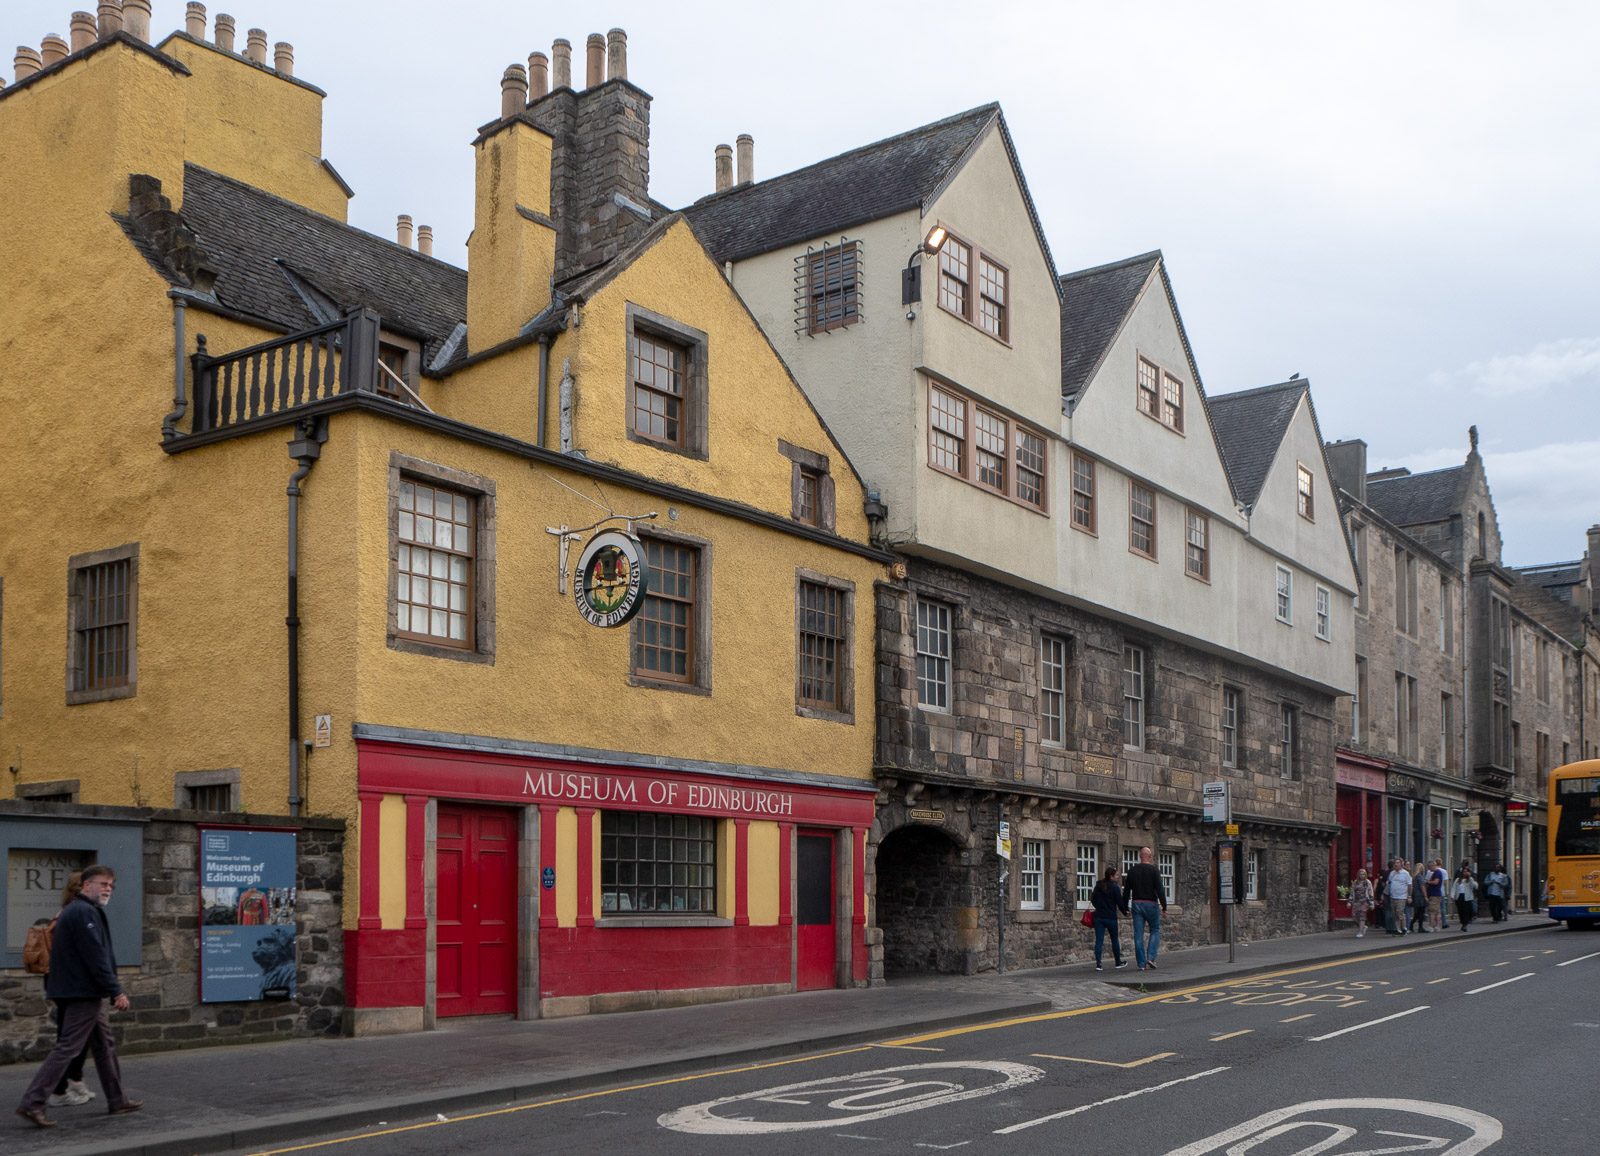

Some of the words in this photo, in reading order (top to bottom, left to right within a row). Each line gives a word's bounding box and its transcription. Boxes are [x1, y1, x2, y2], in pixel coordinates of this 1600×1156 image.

[575, 568, 592, 619] MUSEUM
[591, 613, 604, 626] OF
[606, 560, 640, 626] EDINBURGH
[522, 771, 638, 803] MUSEUM
[648, 780, 678, 805] OF
[687, 785, 793, 815] EDINBURGH
[206, 862, 251, 872] Museum
[252, 862, 265, 872] of
[206, 872, 261, 884] Edinburgh
[1230, 980, 1391, 991] BUS
[1160, 991, 1355, 1007] STOP
[753, 1077, 965, 1111] 20
